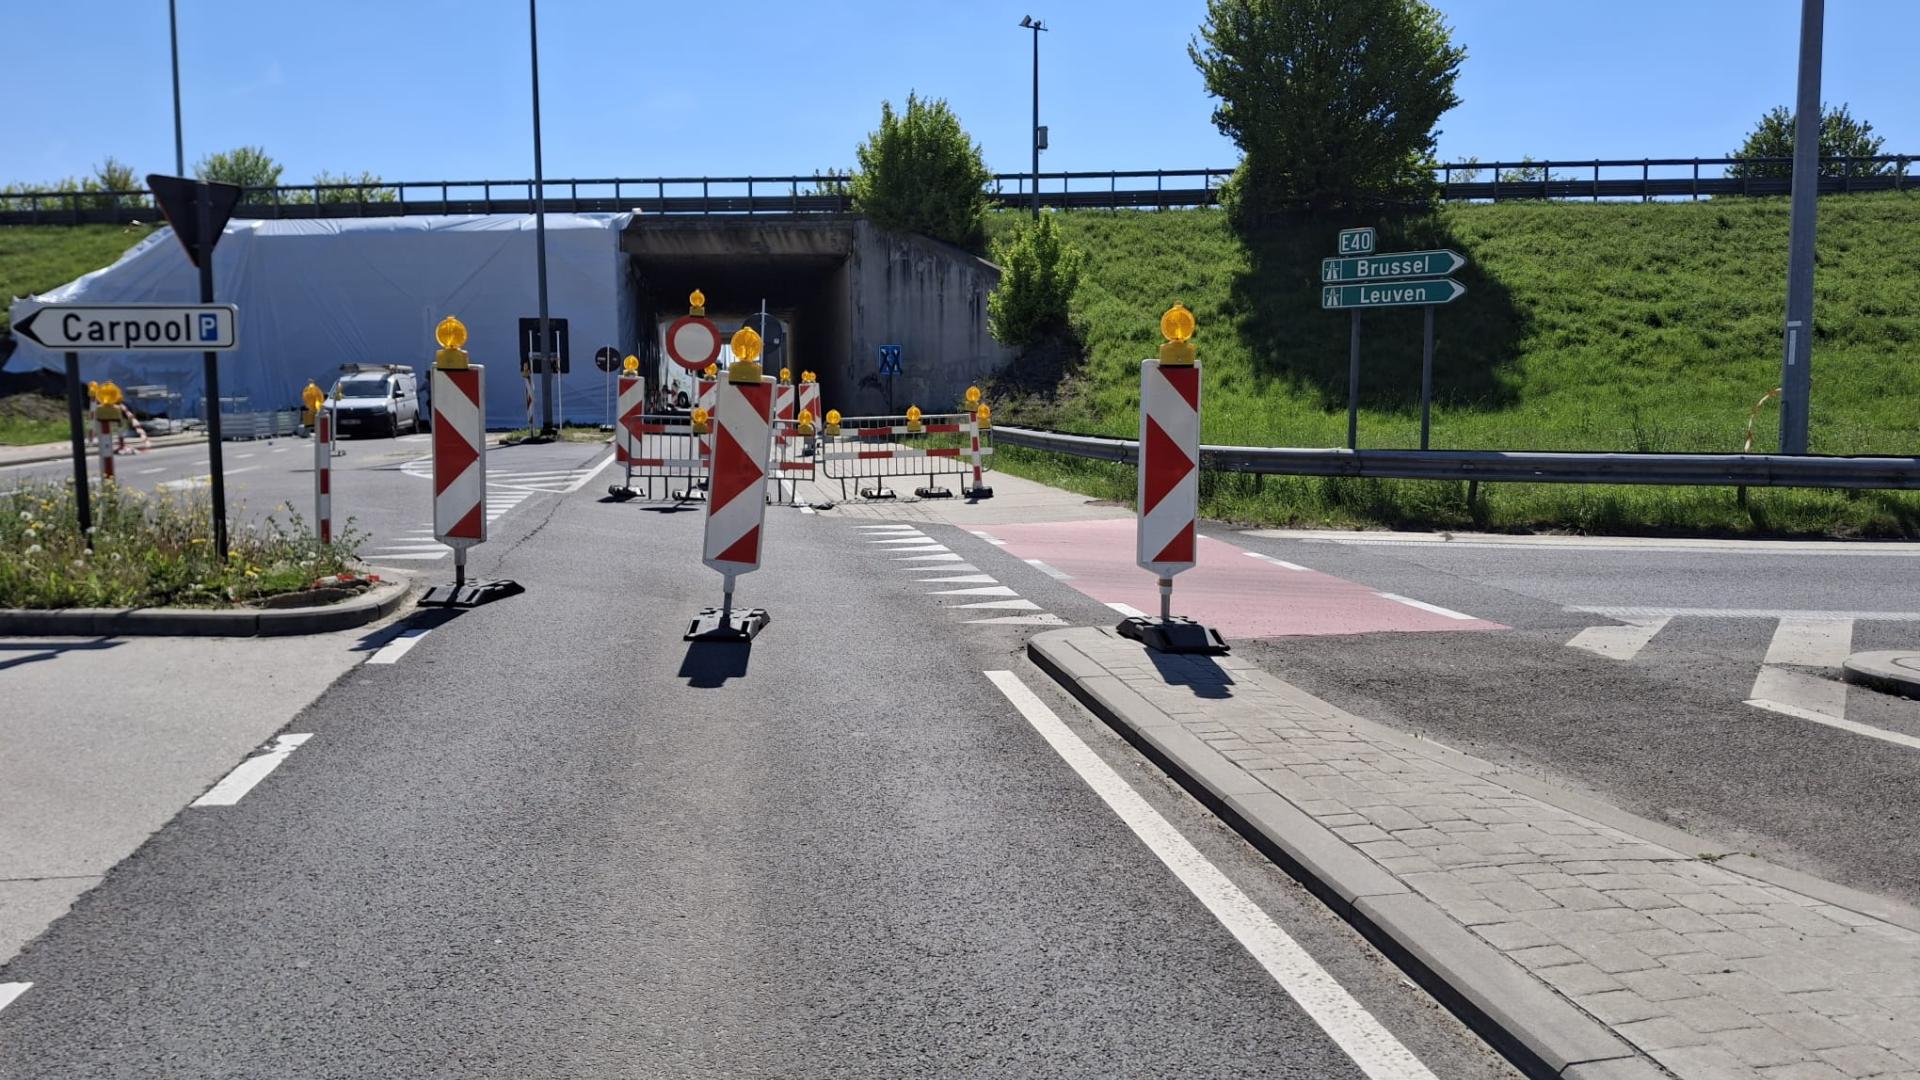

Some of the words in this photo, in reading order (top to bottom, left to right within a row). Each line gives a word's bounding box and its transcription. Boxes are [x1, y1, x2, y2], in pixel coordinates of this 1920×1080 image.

[1342, 232, 1370, 251] E40
[1357, 256, 1429, 277] Brussel
[1360, 287, 1426, 304] Leuven
[62, 313, 191, 349] Carpool
[201, 317, 216, 338] P
